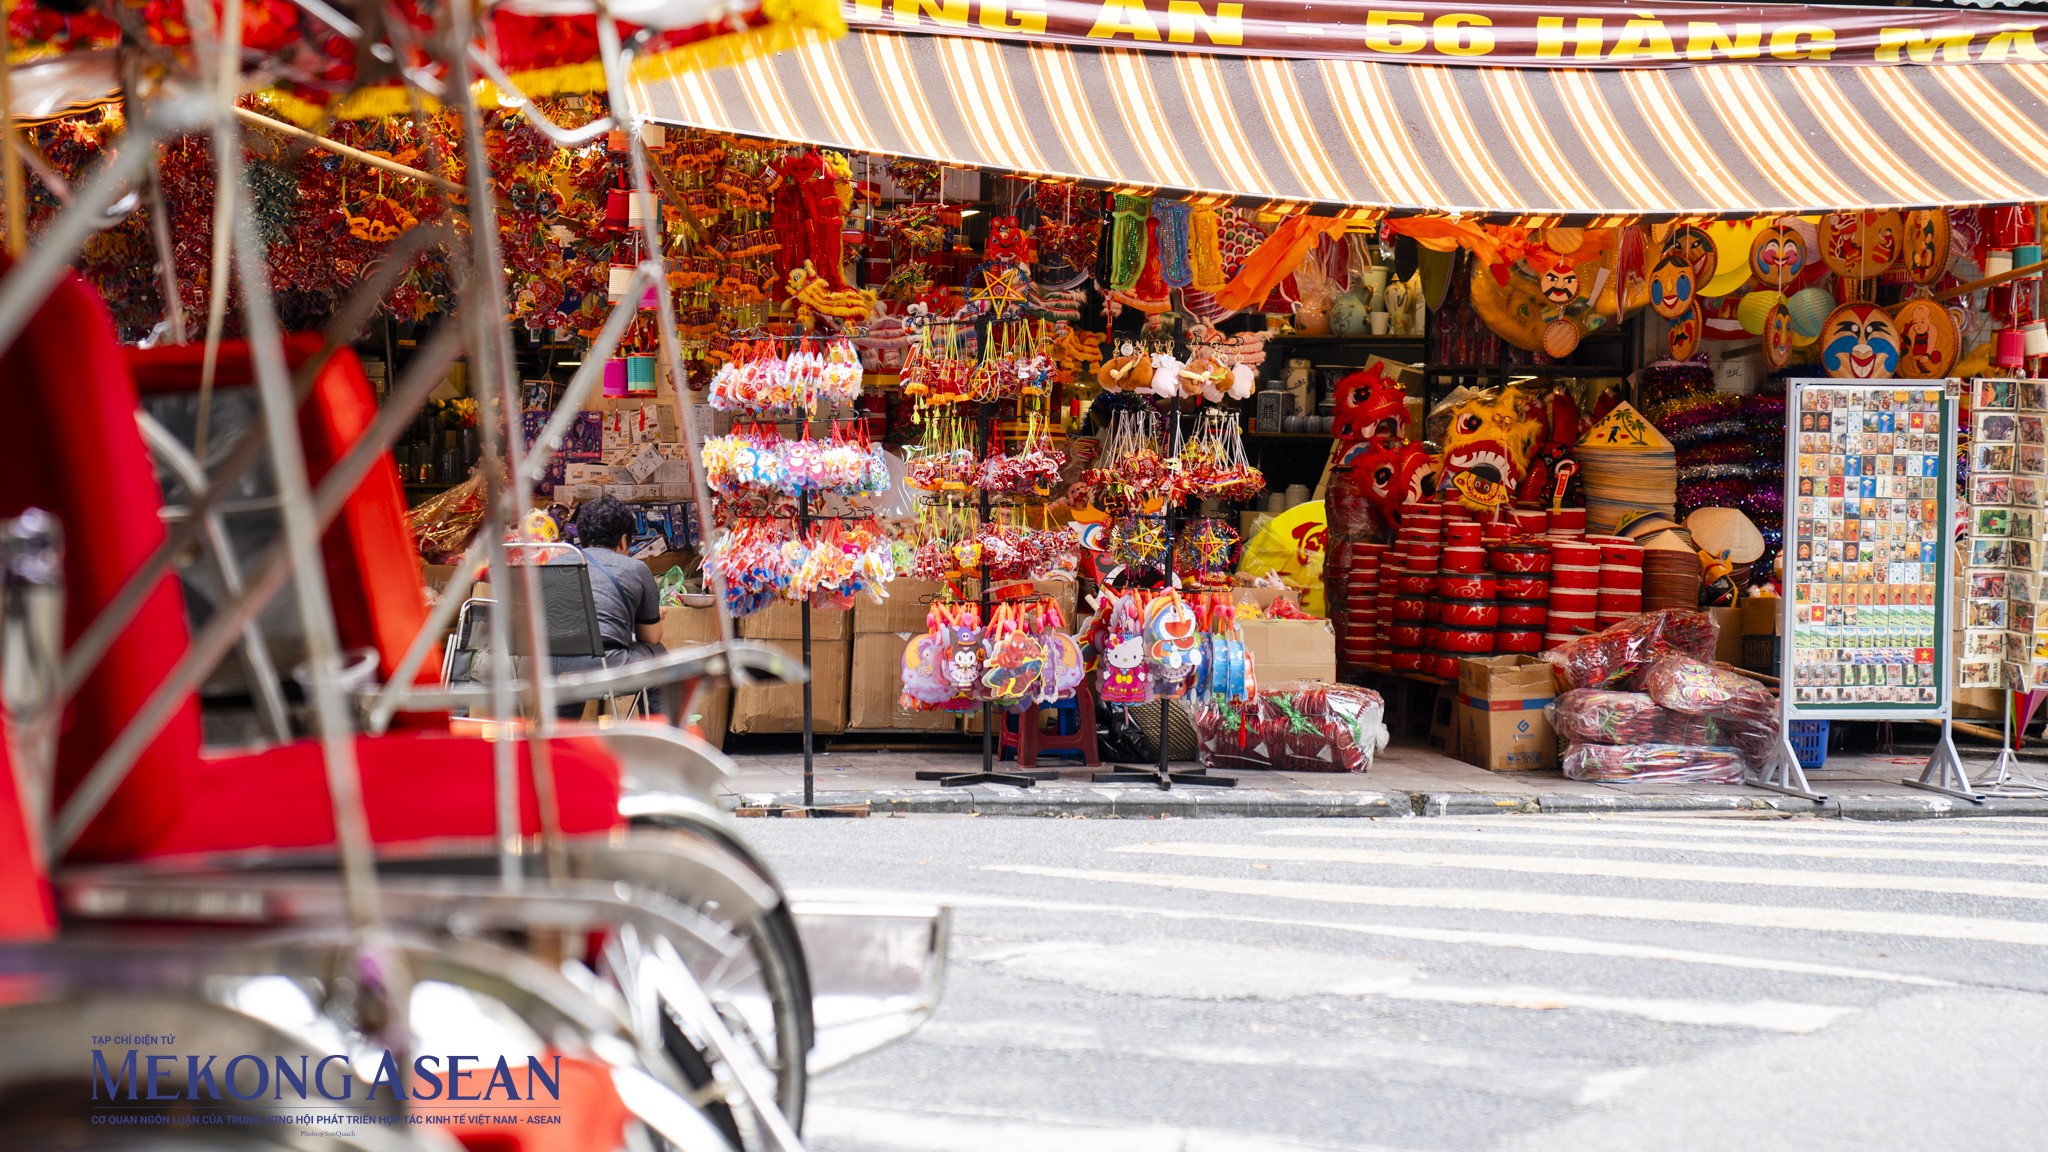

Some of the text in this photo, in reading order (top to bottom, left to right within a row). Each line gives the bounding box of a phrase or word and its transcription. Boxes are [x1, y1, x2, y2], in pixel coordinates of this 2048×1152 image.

[1365, 10, 1496, 56] 56
[1535, 11, 1836, 60] HÀNG
[1874, 23, 2048, 62] MÃ
